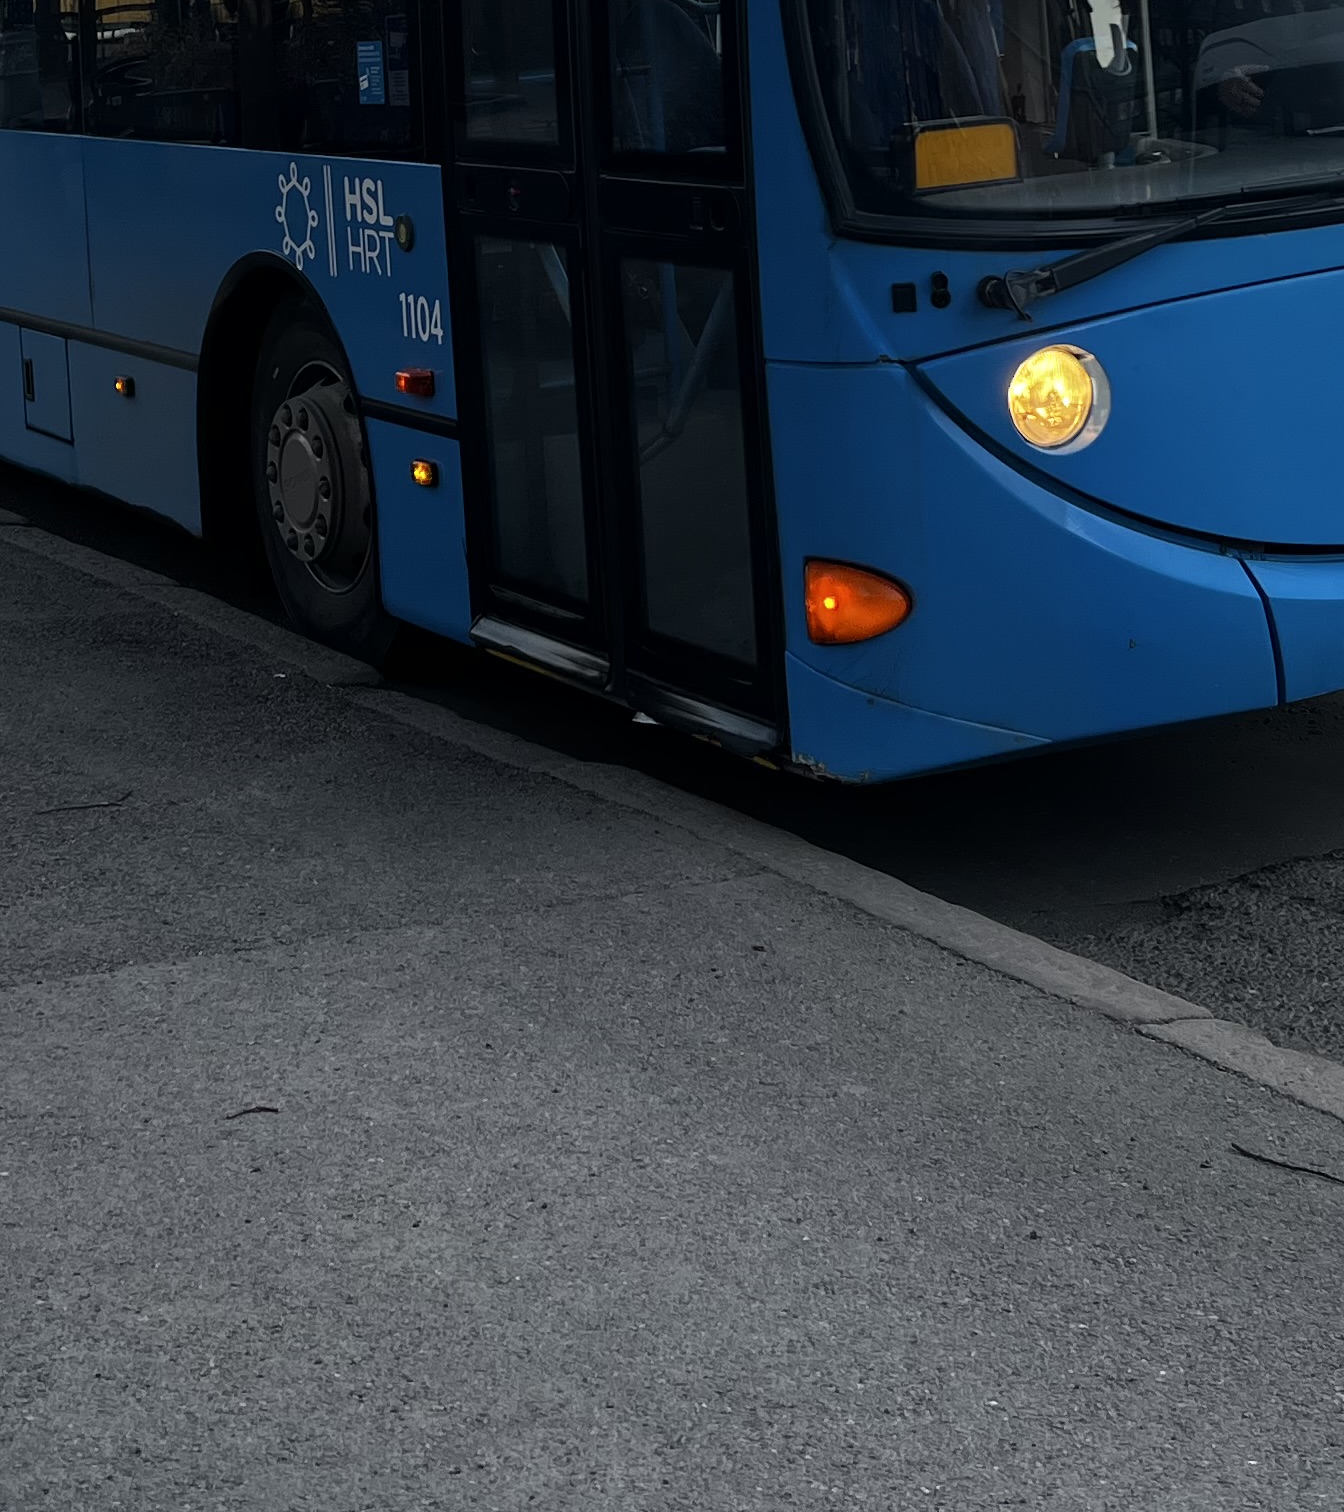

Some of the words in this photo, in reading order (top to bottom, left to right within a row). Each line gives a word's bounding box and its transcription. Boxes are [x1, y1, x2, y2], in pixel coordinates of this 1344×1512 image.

[343, 175, 394, 227] HSL
[346, 226, 395, 278] HRT
[399, 292, 444, 345] 1104
